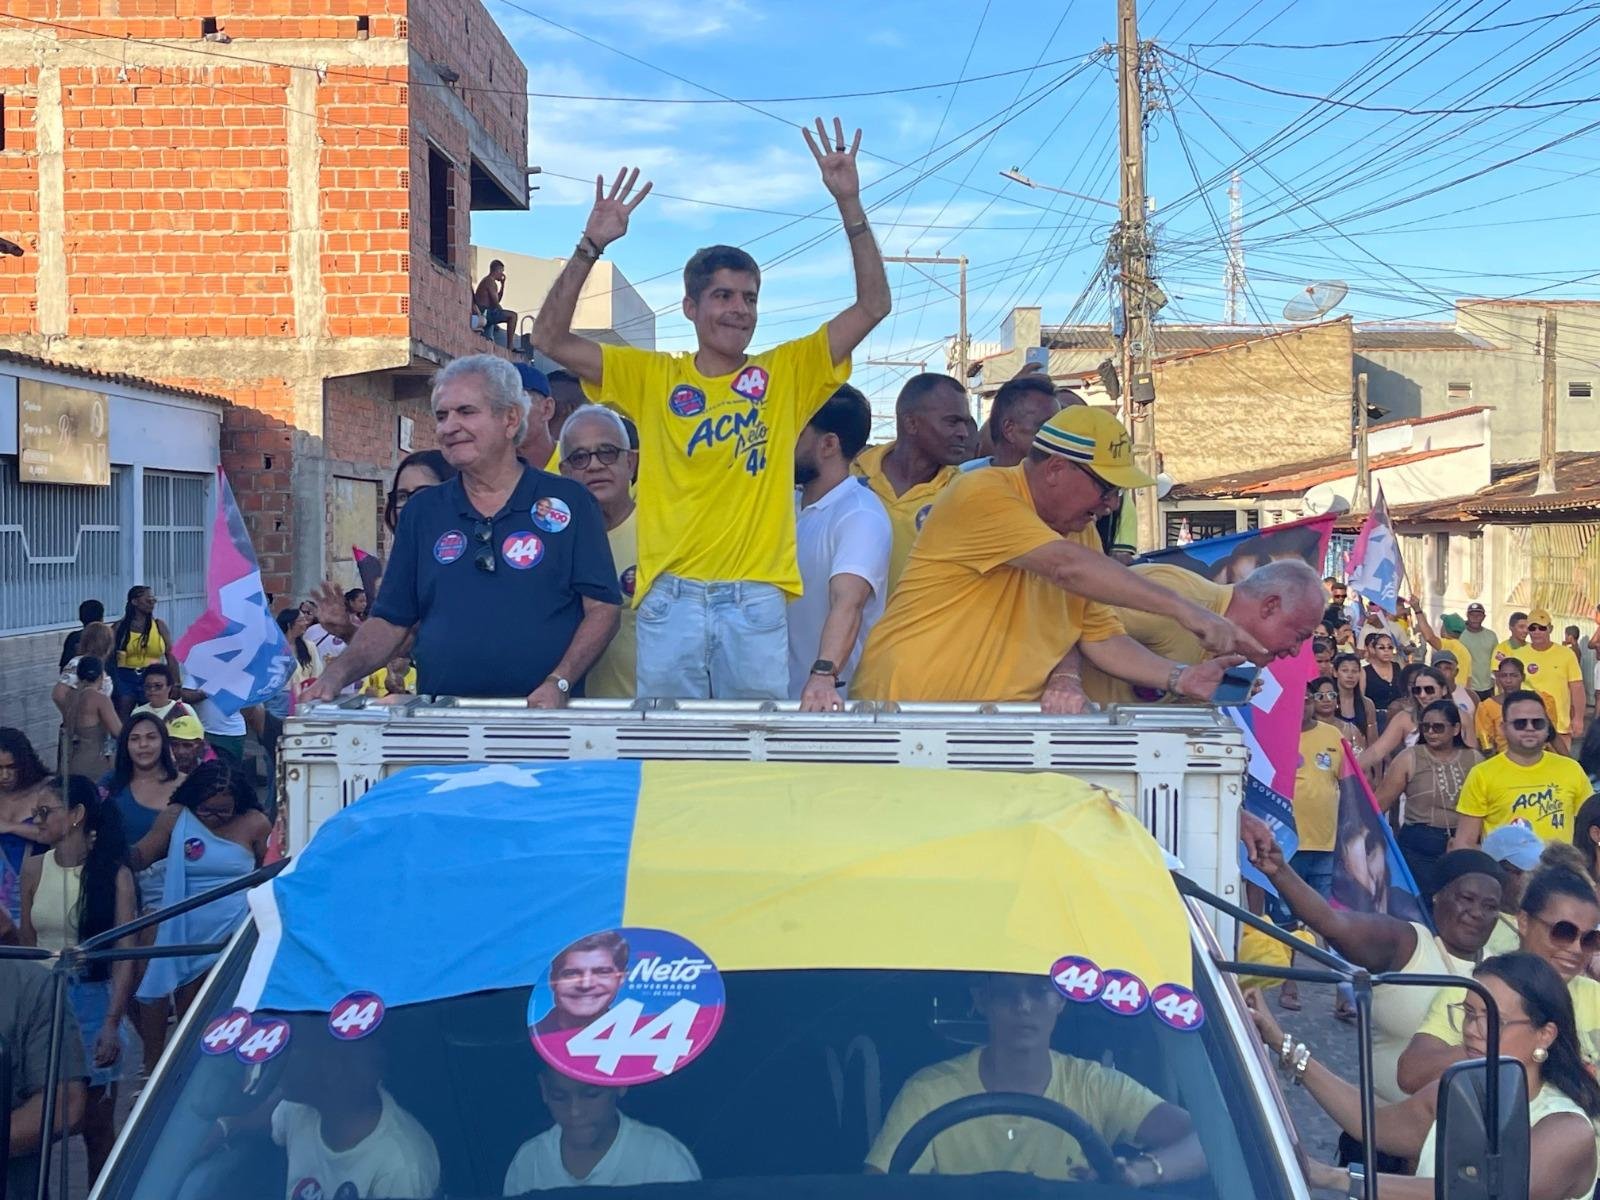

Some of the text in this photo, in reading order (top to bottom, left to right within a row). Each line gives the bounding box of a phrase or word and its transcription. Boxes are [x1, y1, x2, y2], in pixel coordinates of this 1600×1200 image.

[736, 369, 765, 397] 44
[687, 407, 760, 457] ACM
[506, 538, 537, 561] 44
[1512, 788, 1553, 813] ACM
[1552, 813, 1565, 829] 44
[628, 957, 712, 982] Neto
[1054, 965, 1099, 996] 44
[1101, 979, 1141, 1008] 44
[1155, 993, 1198, 1025] 44
[203, 1016, 248, 1048] 44
[331, 1001, 378, 1033] 44
[238, 1025, 285, 1057] 44
[566, 998, 701, 1076] 44
